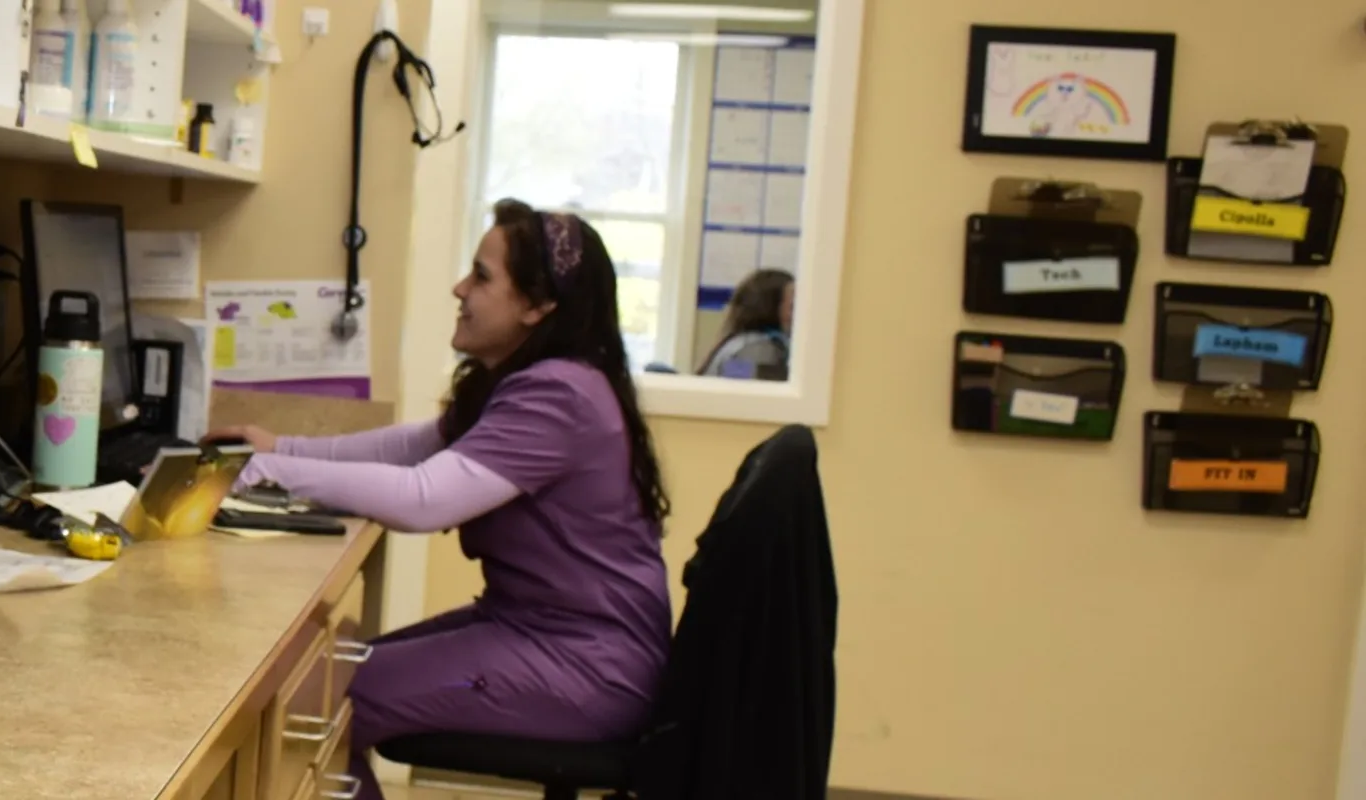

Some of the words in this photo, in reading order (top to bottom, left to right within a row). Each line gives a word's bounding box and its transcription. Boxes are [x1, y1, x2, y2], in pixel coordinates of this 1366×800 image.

[1219, 208, 1276, 229] Cipolla
[1038, 266, 1082, 281] Tech
[1213, 333, 1279, 353] Lapham
